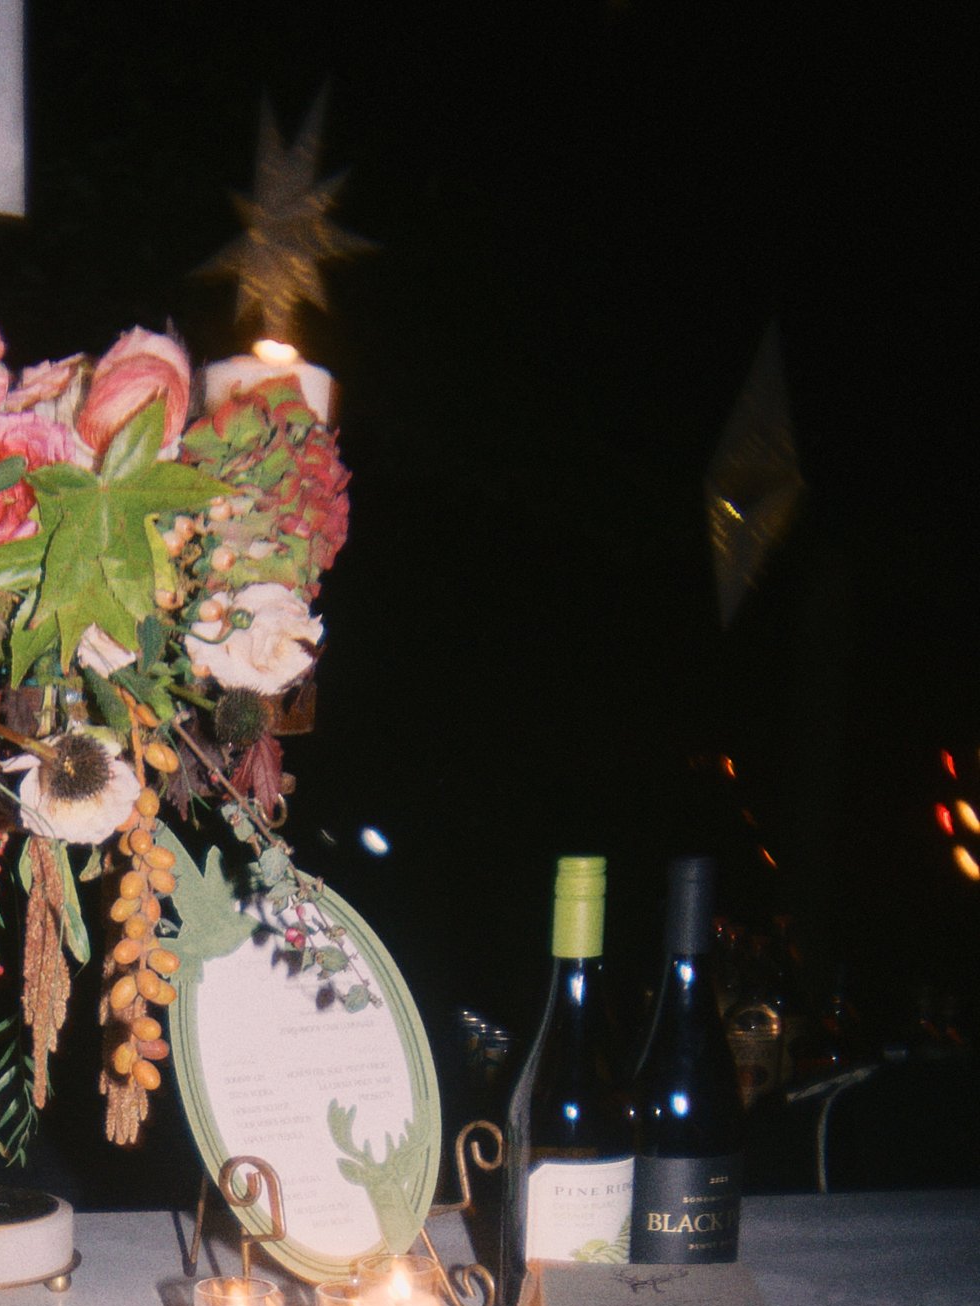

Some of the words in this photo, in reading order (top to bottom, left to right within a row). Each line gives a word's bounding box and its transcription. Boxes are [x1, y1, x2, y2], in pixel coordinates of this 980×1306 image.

[554, 1186, 599, 1196] PINE
[606, 1182, 632, 1195] RID
[647, 1212, 723, 1233] BLACK
